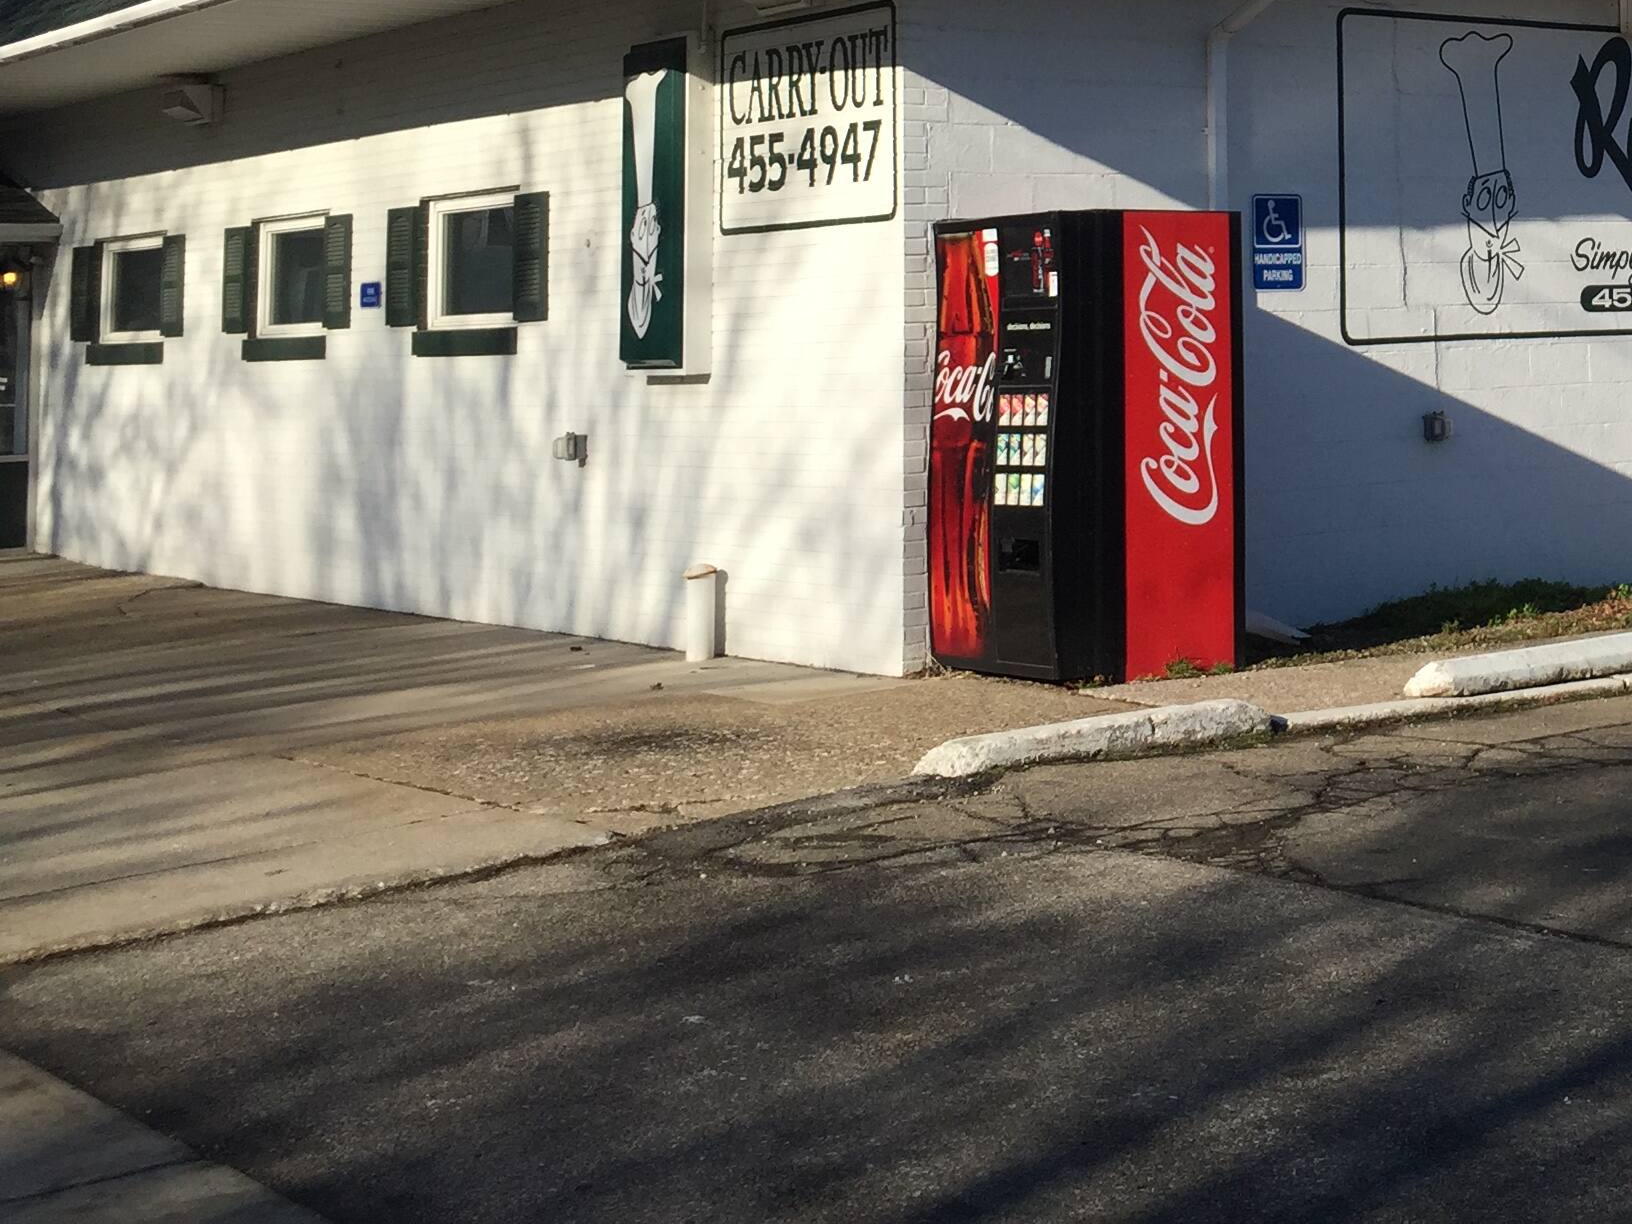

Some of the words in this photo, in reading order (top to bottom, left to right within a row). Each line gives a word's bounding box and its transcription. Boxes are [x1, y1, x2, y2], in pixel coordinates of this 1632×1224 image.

[729, 25, 889, 126] CARRY-OUT
[727, 118, 883, 195] 455-4947
[1254, 252, 1302, 265] HANDICAPPED
[1263, 269, 1293, 282] PARKING
[1139, 224, 1219, 525] Coca-Cola
